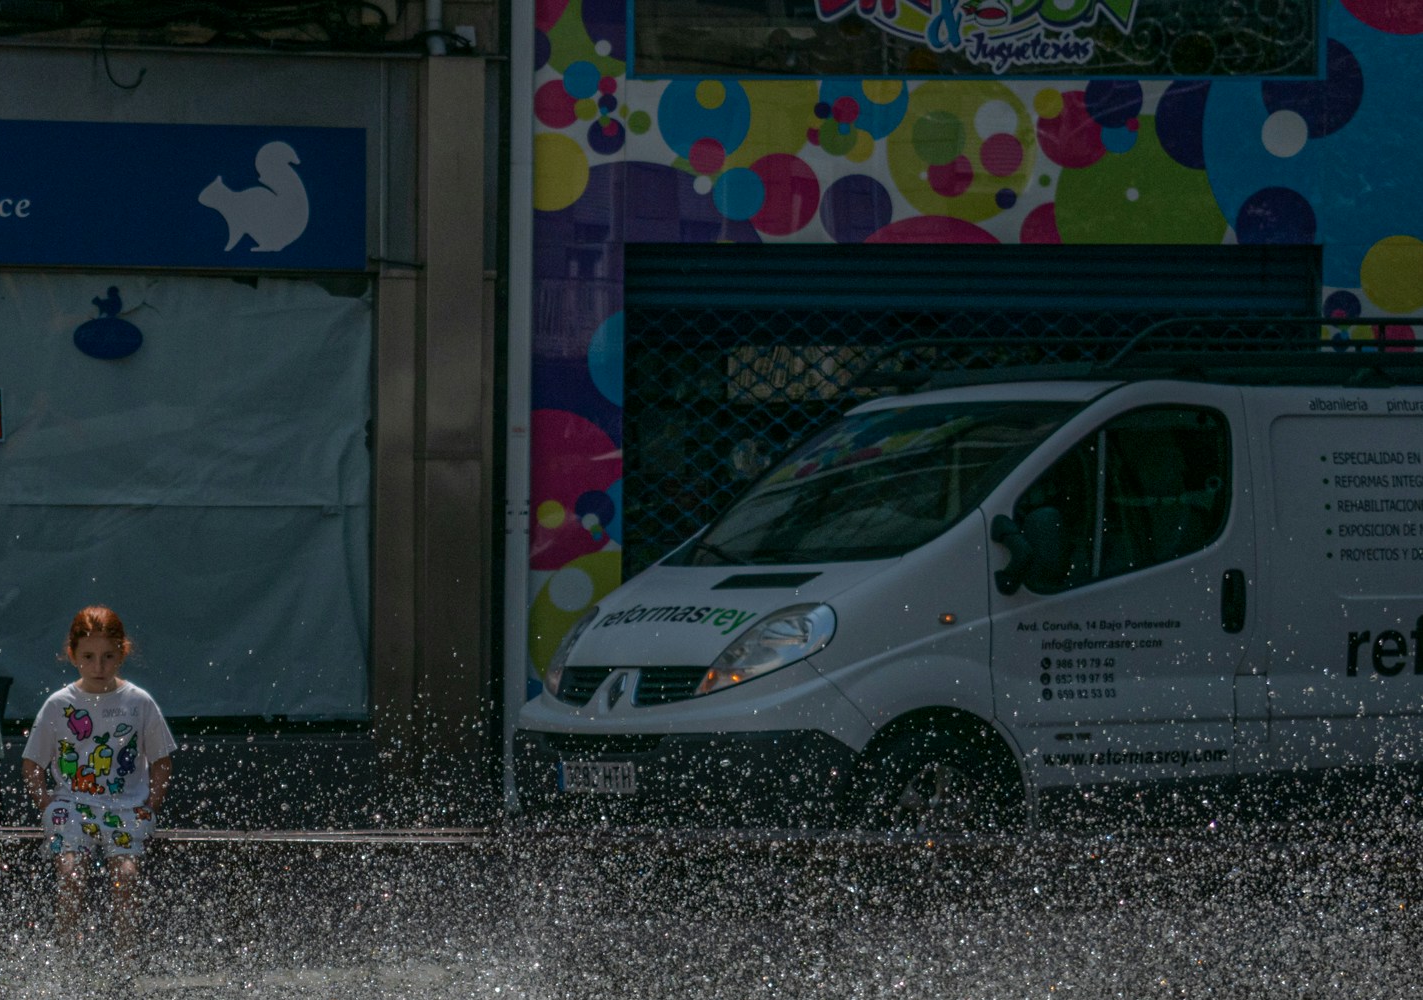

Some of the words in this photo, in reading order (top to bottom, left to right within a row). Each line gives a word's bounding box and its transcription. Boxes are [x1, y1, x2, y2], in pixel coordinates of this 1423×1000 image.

[1333, 452, 1404, 465] ESPECIALIDAD
[1407, 452, 1421, 464] EN
[1335, 475, 1389, 488] REFORMAS
[1339, 524, 1400, 537] EXPOSICION
[1403, 524, 1416, 536] DE
[1341, 548, 1399, 561] PROYECTOS
[1402, 549, 1408, 560] Y
[593, 604, 758, 635] reformasrey
[1017, 621, 1039, 632] Avd.
[1086, 620, 1096, 630] 14
[1099, 620, 1122, 632] Bajo
[1124, 618, 1181, 630] Pontevedra
[1042, 747, 1228, 767] www.reformasrey.com
